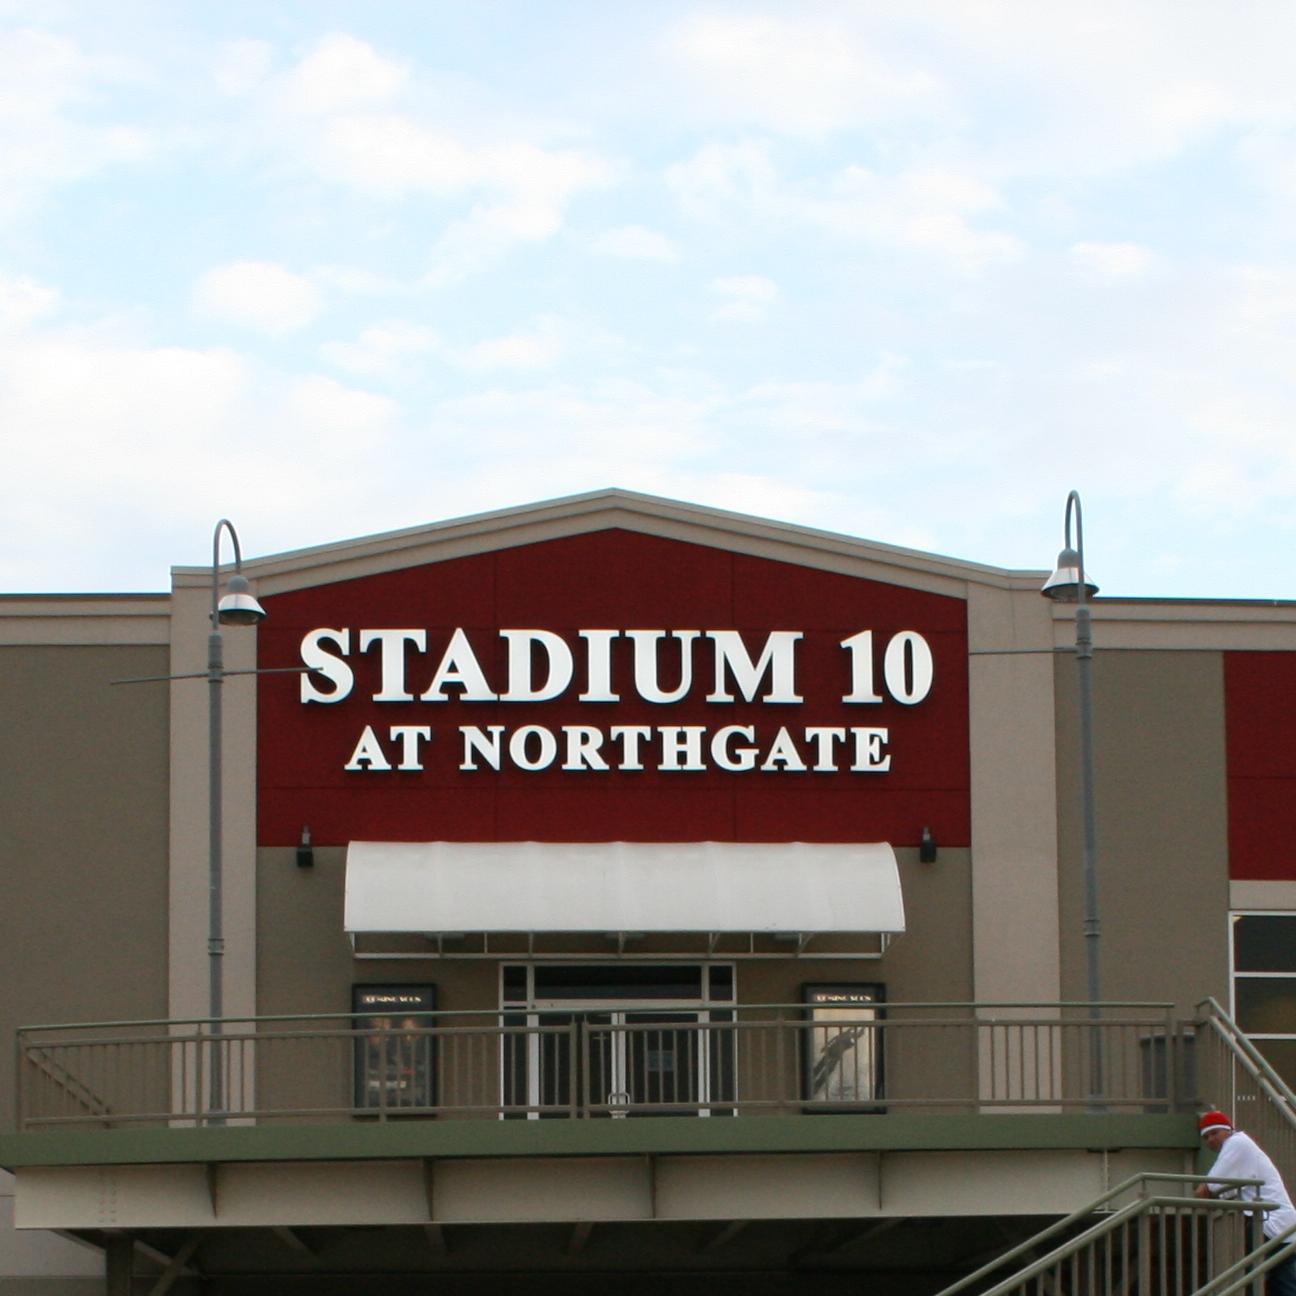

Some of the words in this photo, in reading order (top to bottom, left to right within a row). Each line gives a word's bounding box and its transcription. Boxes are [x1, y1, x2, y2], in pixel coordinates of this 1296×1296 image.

[300, 627, 804, 705] STADIUM
[840, 629, 934, 705] 10
[344, 725, 432, 771] AT
[458, 725, 892, 772] NORTHGATE
